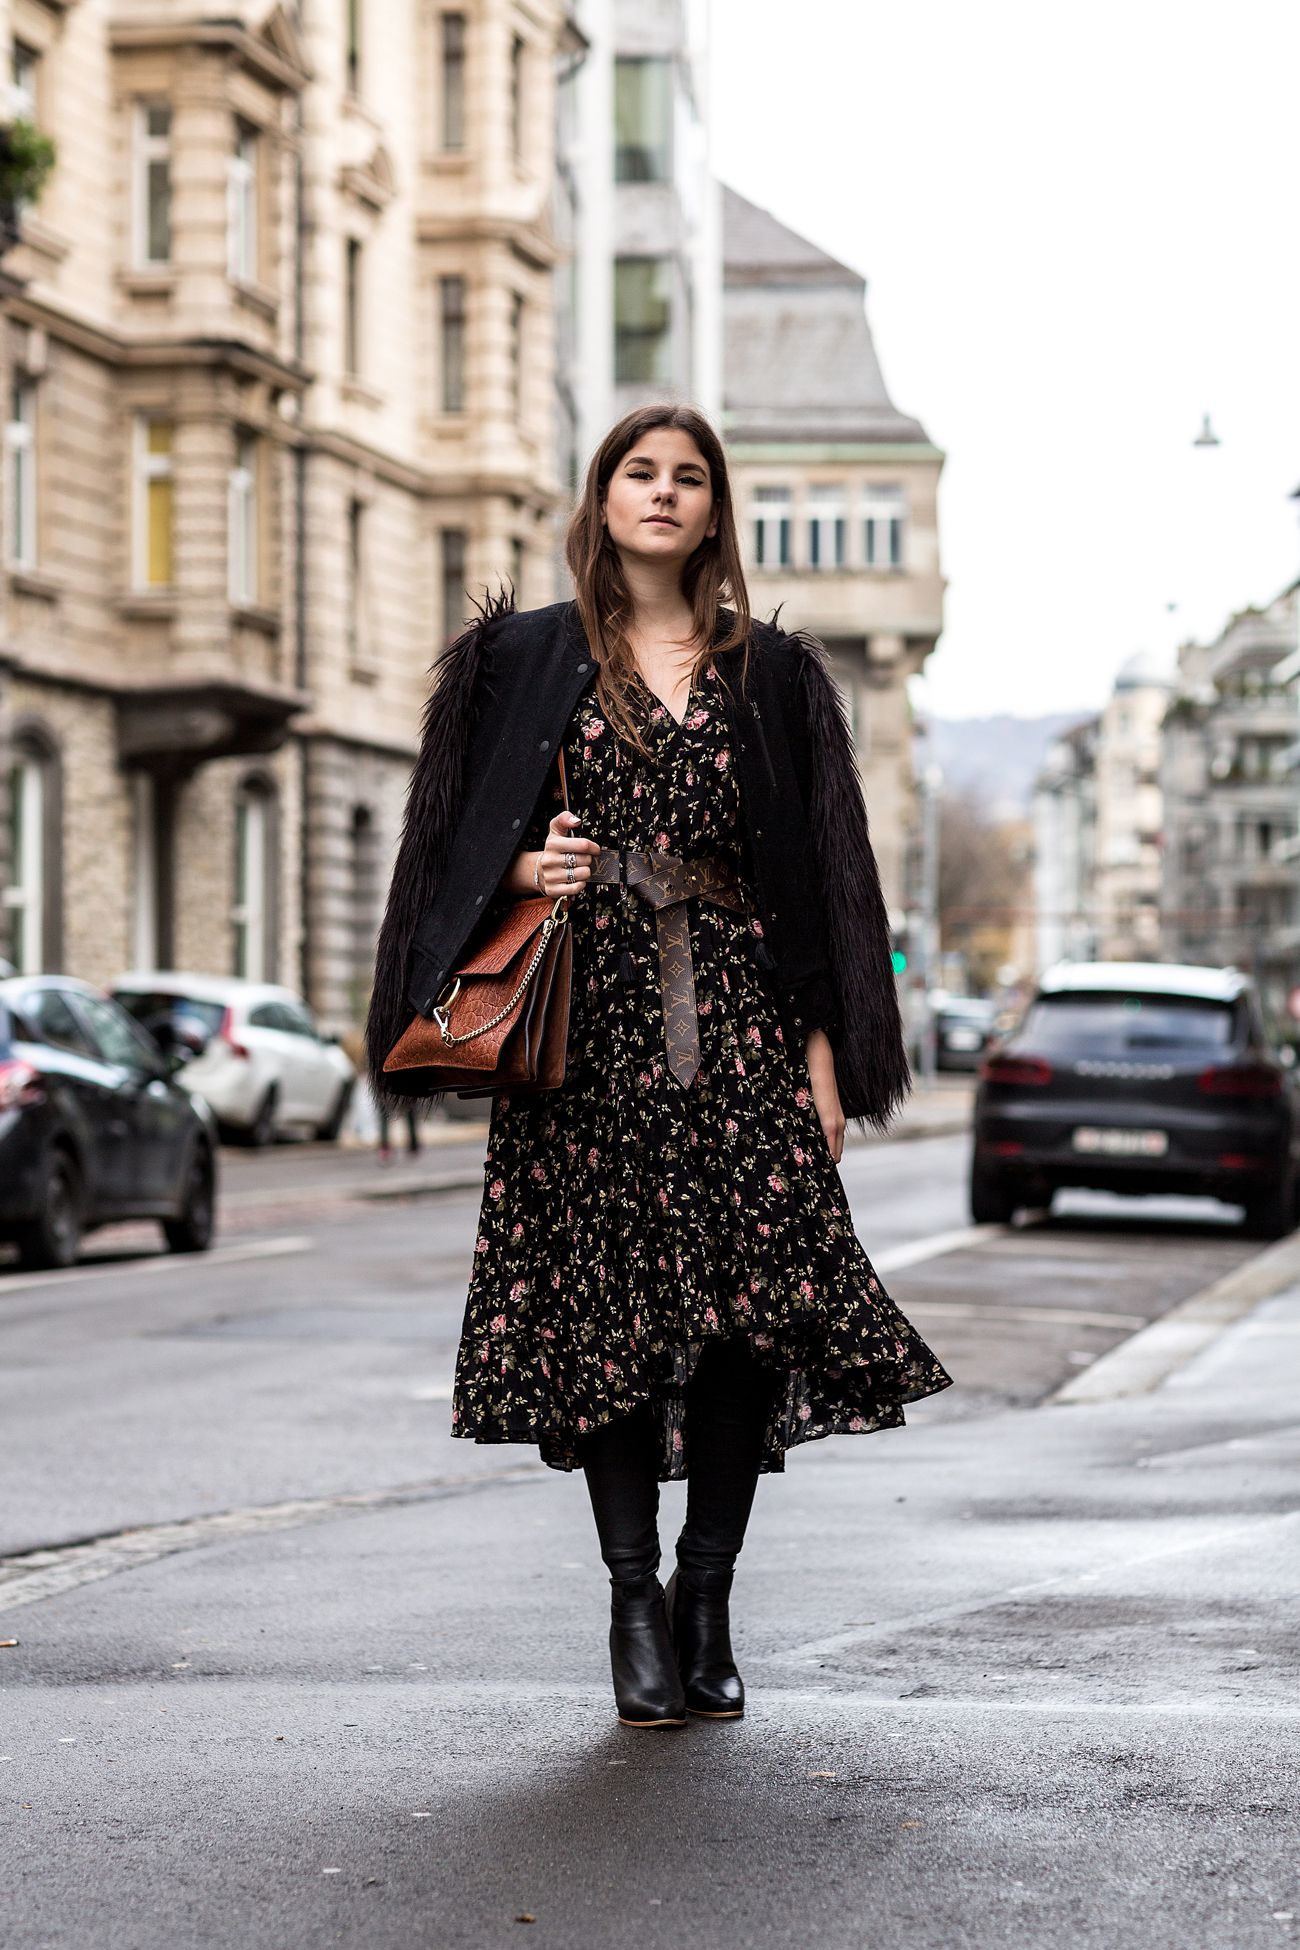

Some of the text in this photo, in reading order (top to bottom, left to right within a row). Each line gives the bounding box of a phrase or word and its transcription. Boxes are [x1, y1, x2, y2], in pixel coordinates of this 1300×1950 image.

[665, 931, 684, 949] LV
[669, 989, 690, 1008] LV
[675, 1047, 695, 1067] LV
